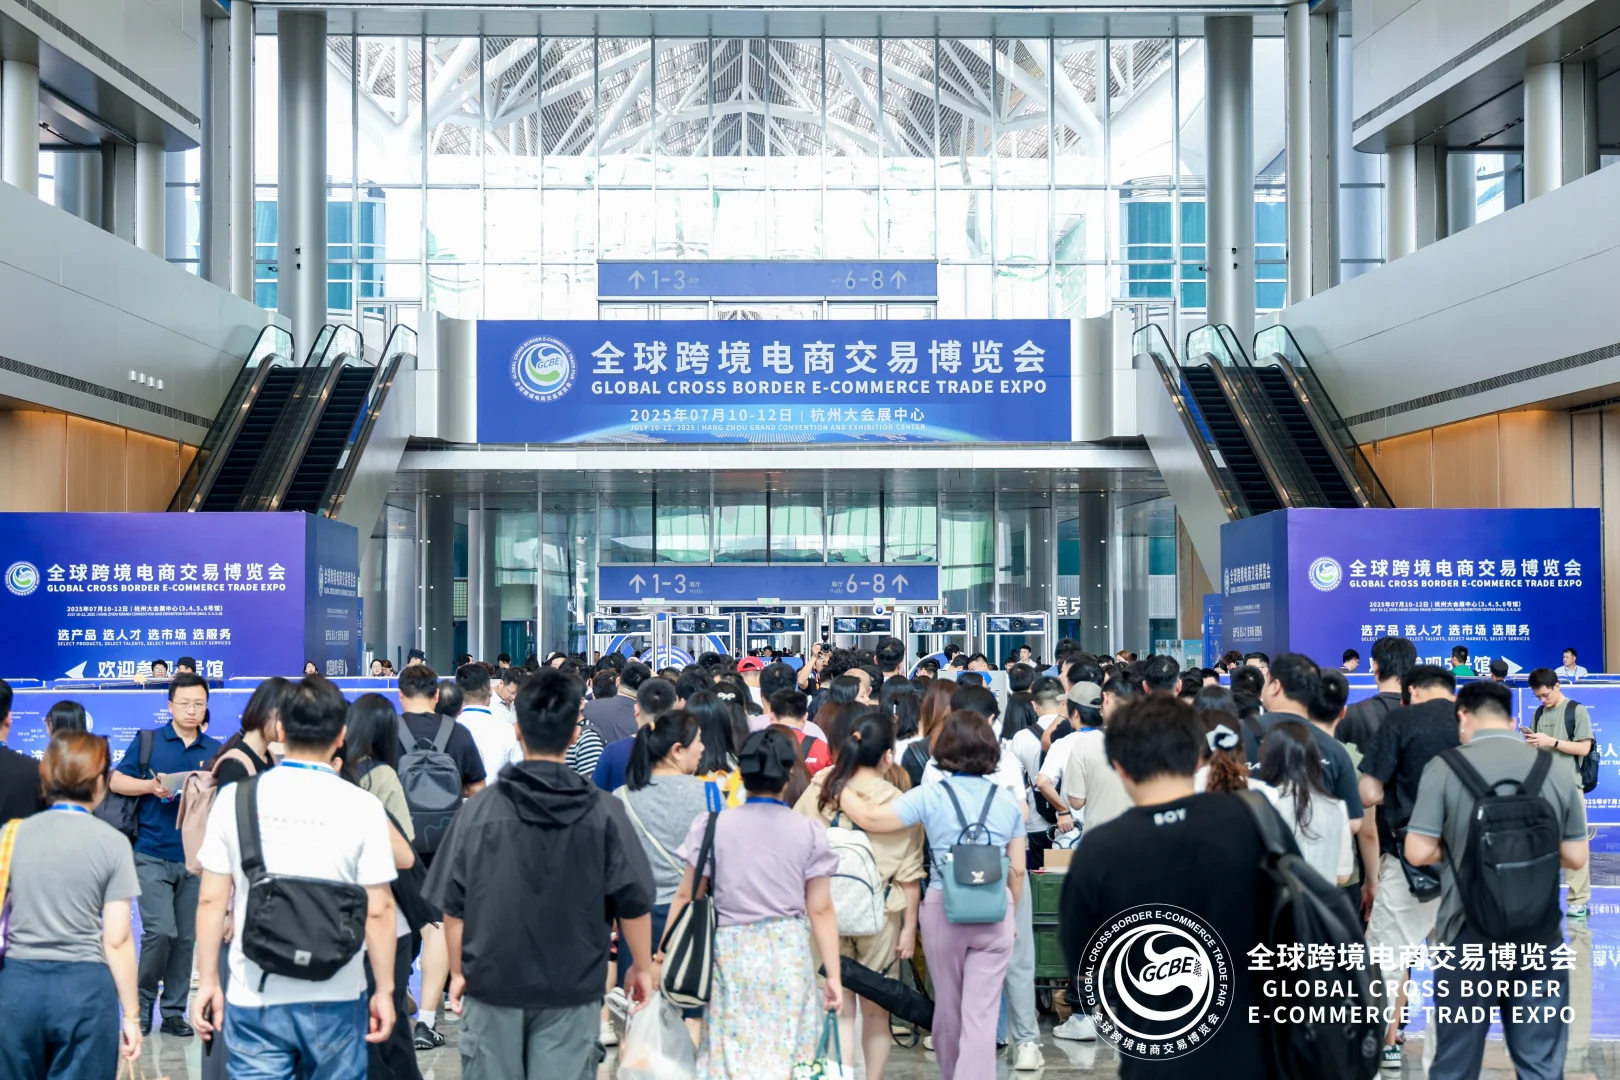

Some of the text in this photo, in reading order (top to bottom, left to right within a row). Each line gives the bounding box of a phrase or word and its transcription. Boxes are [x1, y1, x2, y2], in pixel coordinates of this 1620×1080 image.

[652, 269, 686, 290] 1-3
[845, 269, 884, 290] 6-8
[537, 357, 561, 369] GCBE
[590, 339, 1046, 375] 全球跨境电商交易博览会
[591, 379, 1047, 395] GLOBAL CROSS BORDER E-COMMERCE TRADE EXPO
[629, 407, 925, 423] 2025年07月10-12日 杭州大会展中心
[650, 424, 675, 432] 10-12,
[46, 562, 286, 582] 全球跨境电商交易博览会
[1349, 558, 1582, 578] 全球跨境电商交易博览会
[46, 583, 286, 593] GLOBAL CROSS BORDER E-COMMERCE TRADE EXPO
[652, 573, 687, 594] 1-3
[846, 573, 886, 594] 6-8
[1349, 579, 1583, 588] GLOBAL CROSS BORDER E-COMMERCE TRADE EXPO
[66, 605, 129, 613] 2025年07月10-12日
[1369, 601, 1429, 609] 2025年07月10-12日
[57, 628, 232, 641] 选产品 选人才 选市场 选服务
[1360, 624, 1530, 637] 选产品 选人才 选市场 选服务
